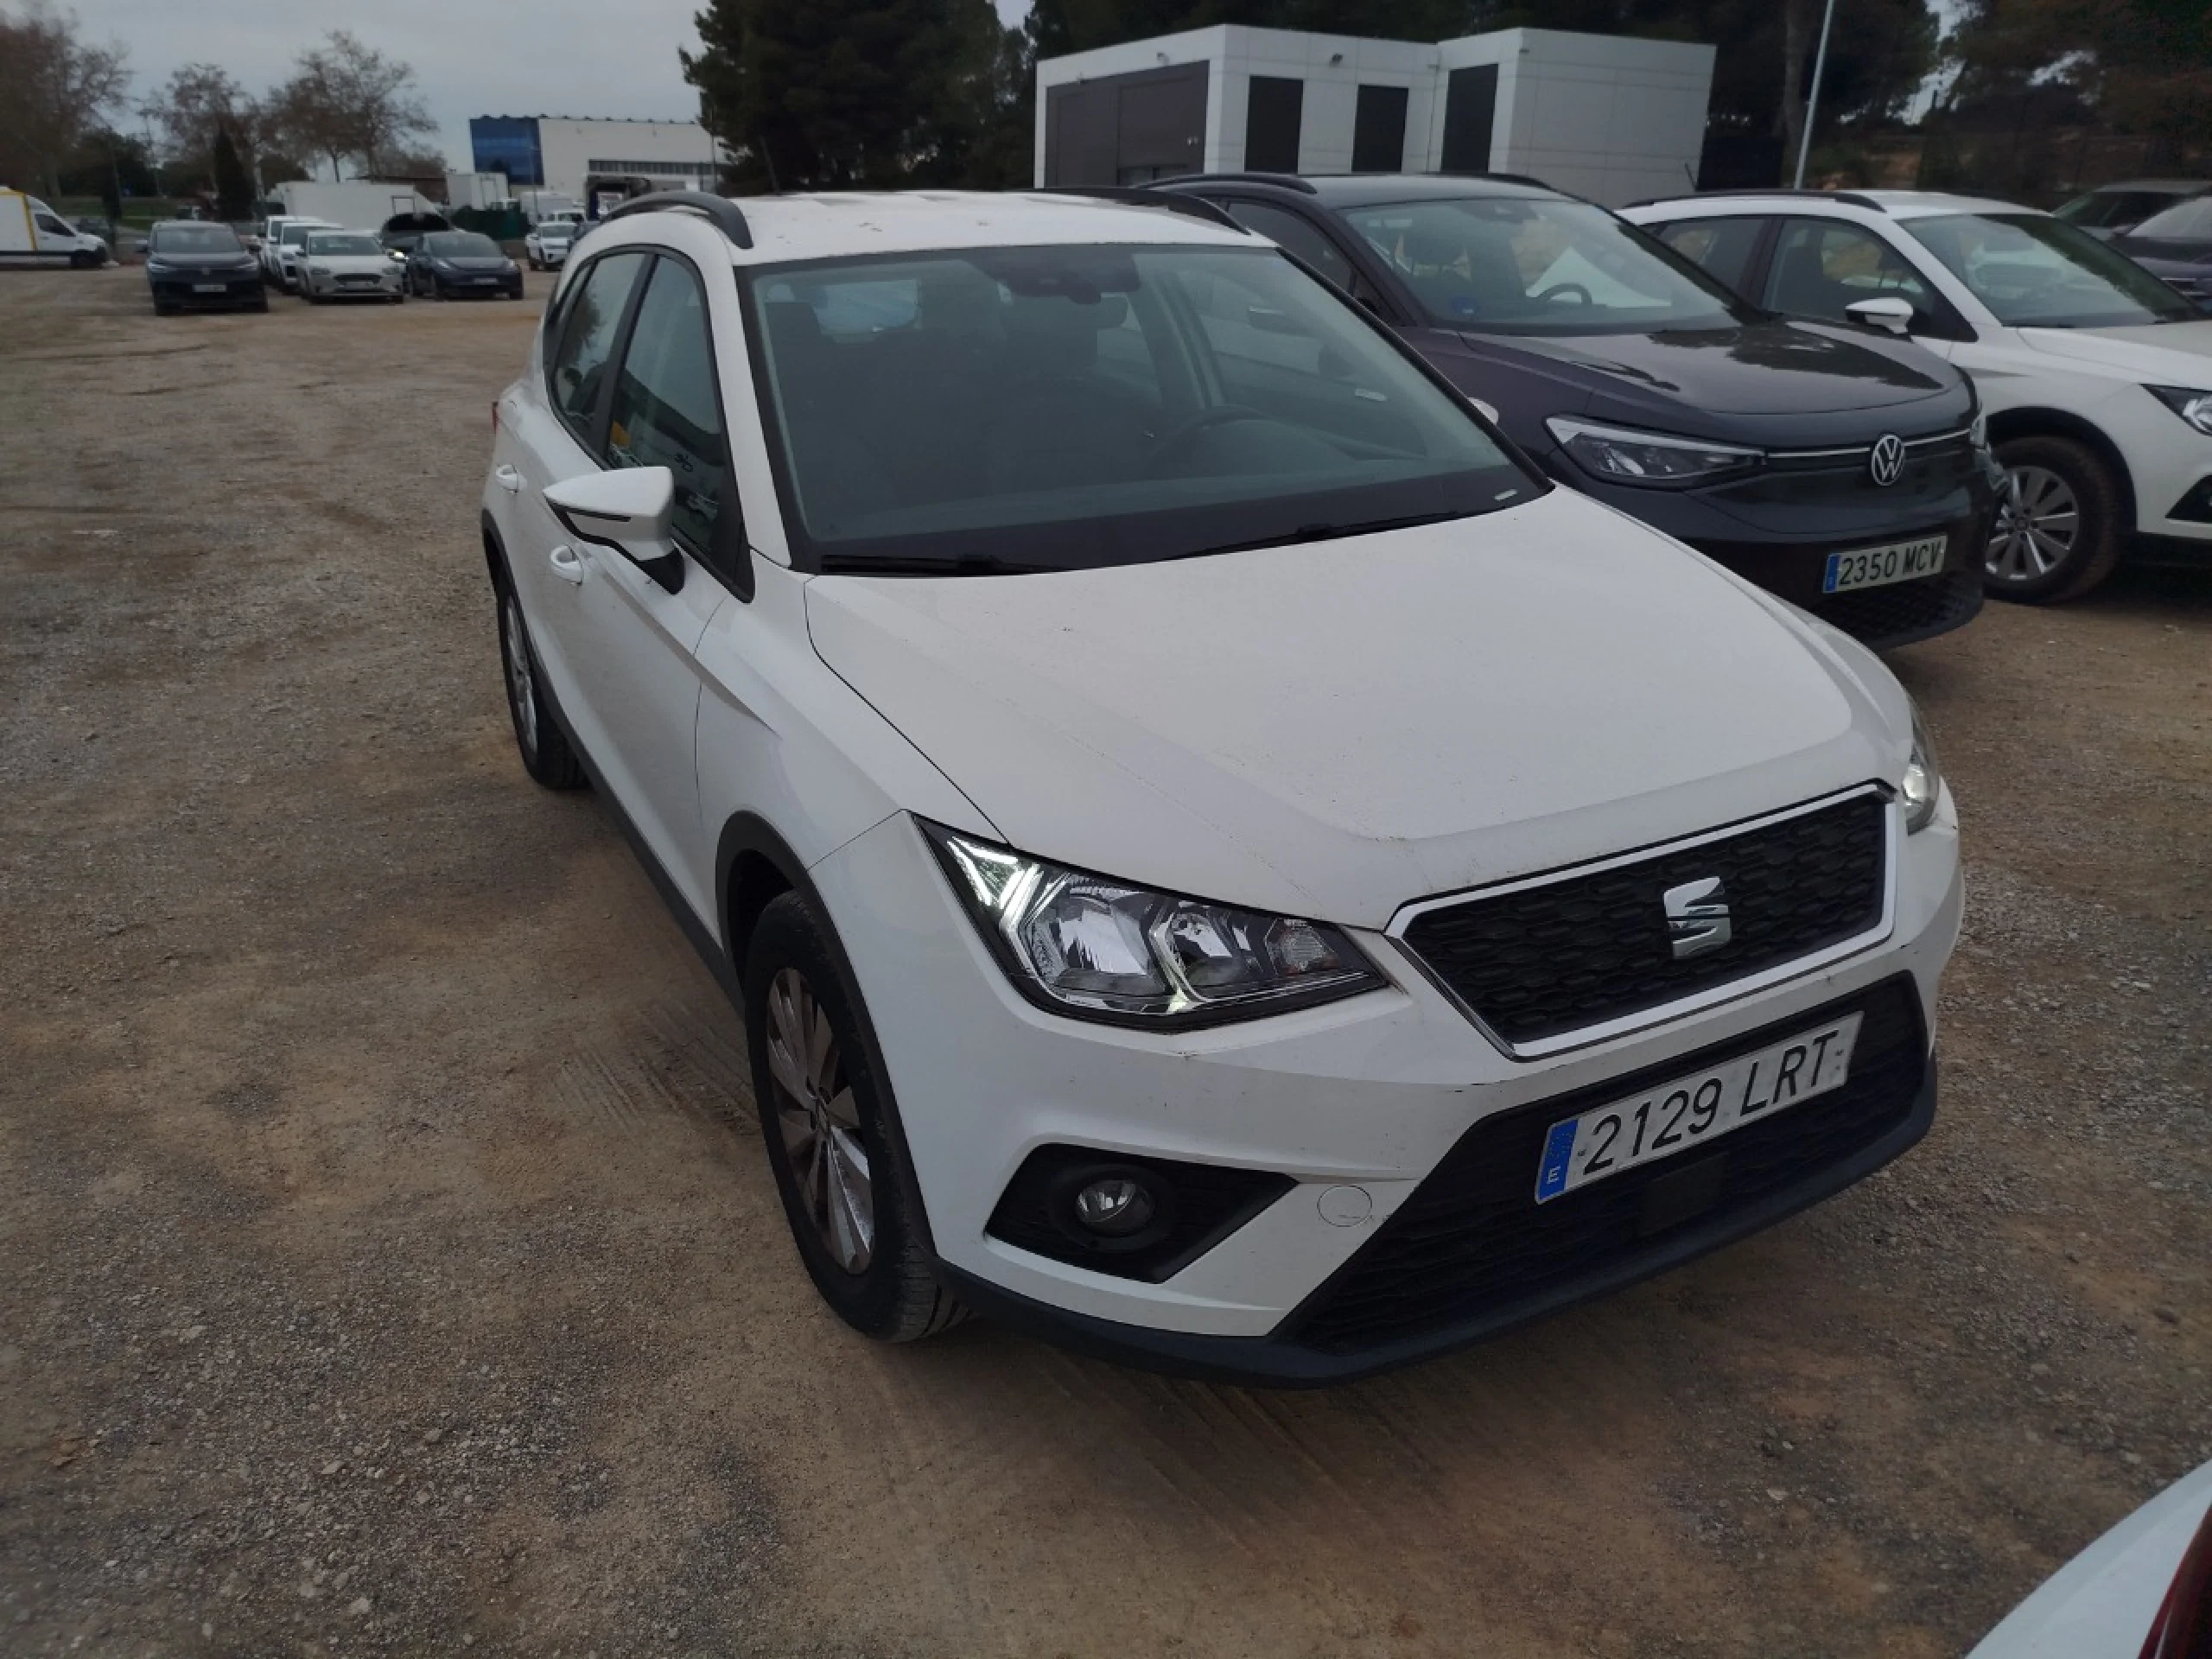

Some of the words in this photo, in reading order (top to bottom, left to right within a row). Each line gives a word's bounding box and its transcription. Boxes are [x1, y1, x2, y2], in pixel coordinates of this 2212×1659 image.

[1840, 551, 1896, 585] 2350
[1904, 541, 1942, 574] MCV
[1583, 1077, 1722, 1175] 2129
[1739, 1029, 1839, 1116] LRT
